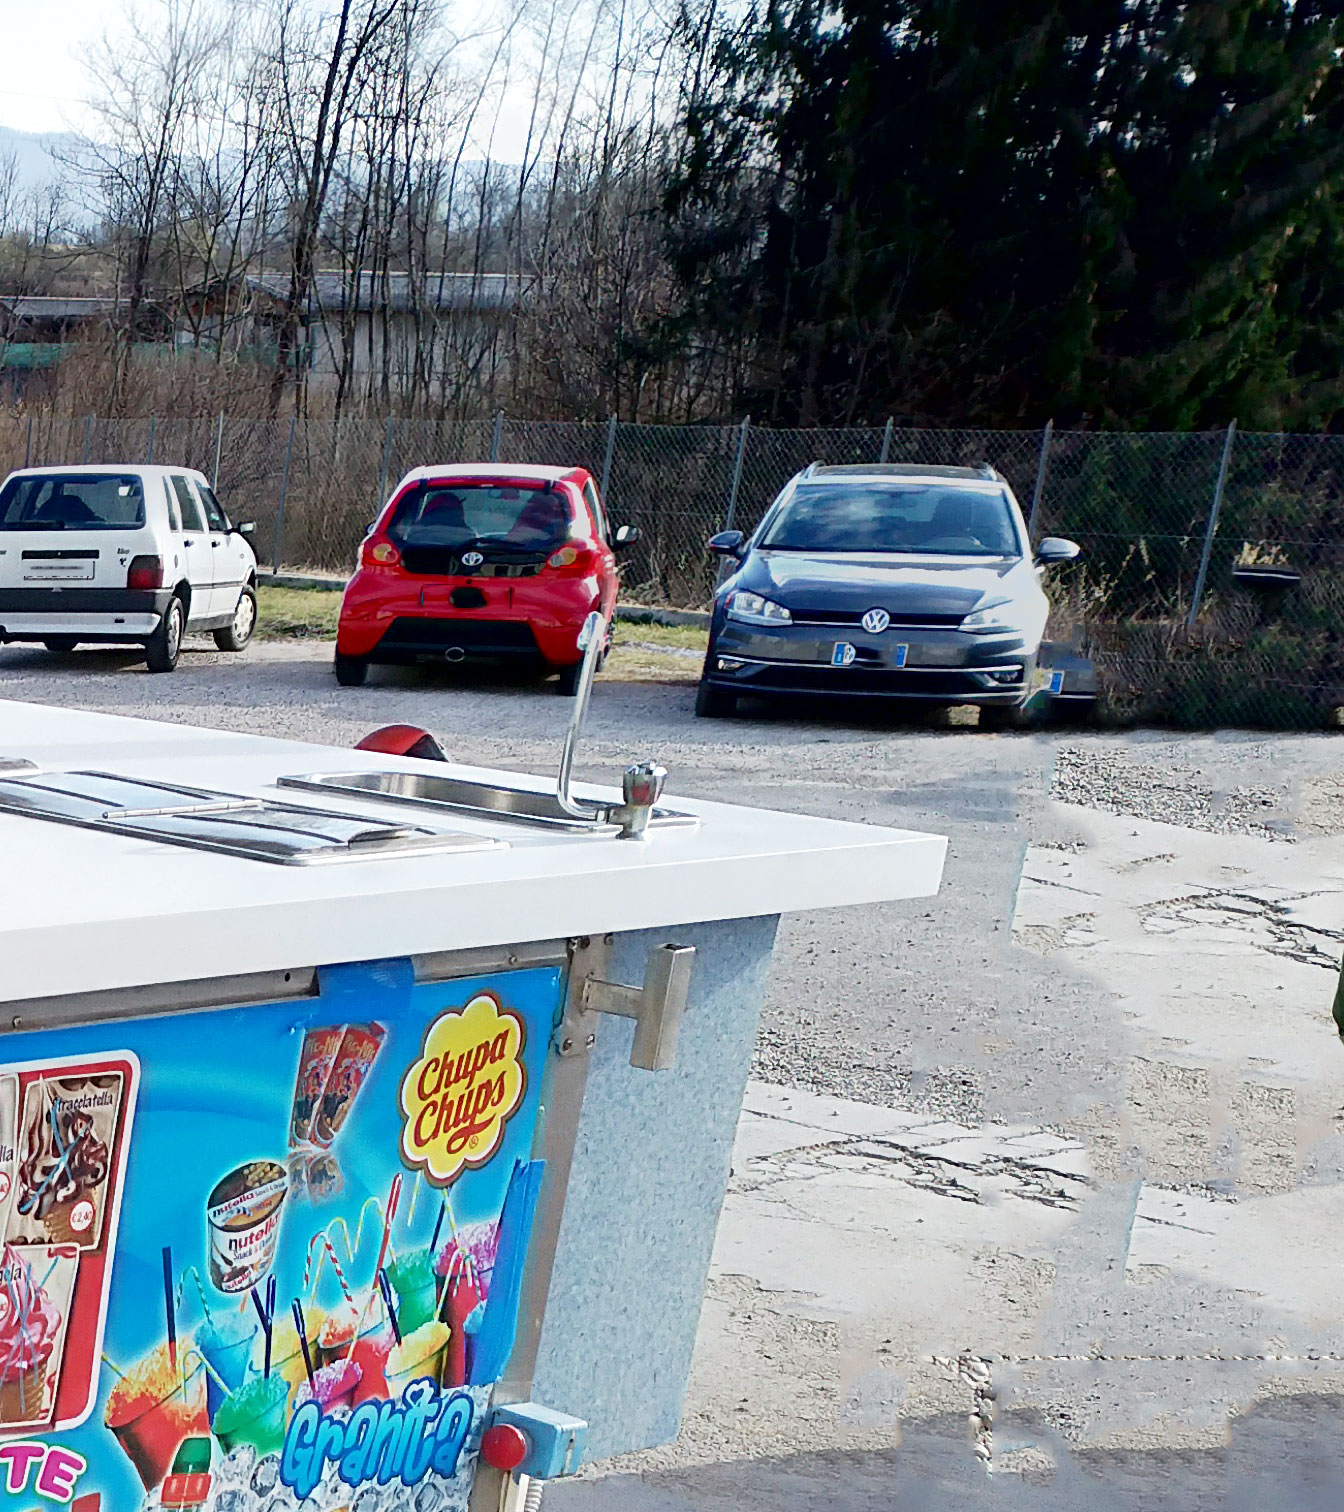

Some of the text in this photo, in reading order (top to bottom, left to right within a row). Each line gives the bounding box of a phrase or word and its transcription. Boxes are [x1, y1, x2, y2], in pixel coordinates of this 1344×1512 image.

[417, 1029, 510, 1101] Chupa
[413, 1072, 506, 1154] Chups
[227, 1214, 280, 1252] nutella
[280, 1378, 475, 1500] Granita
